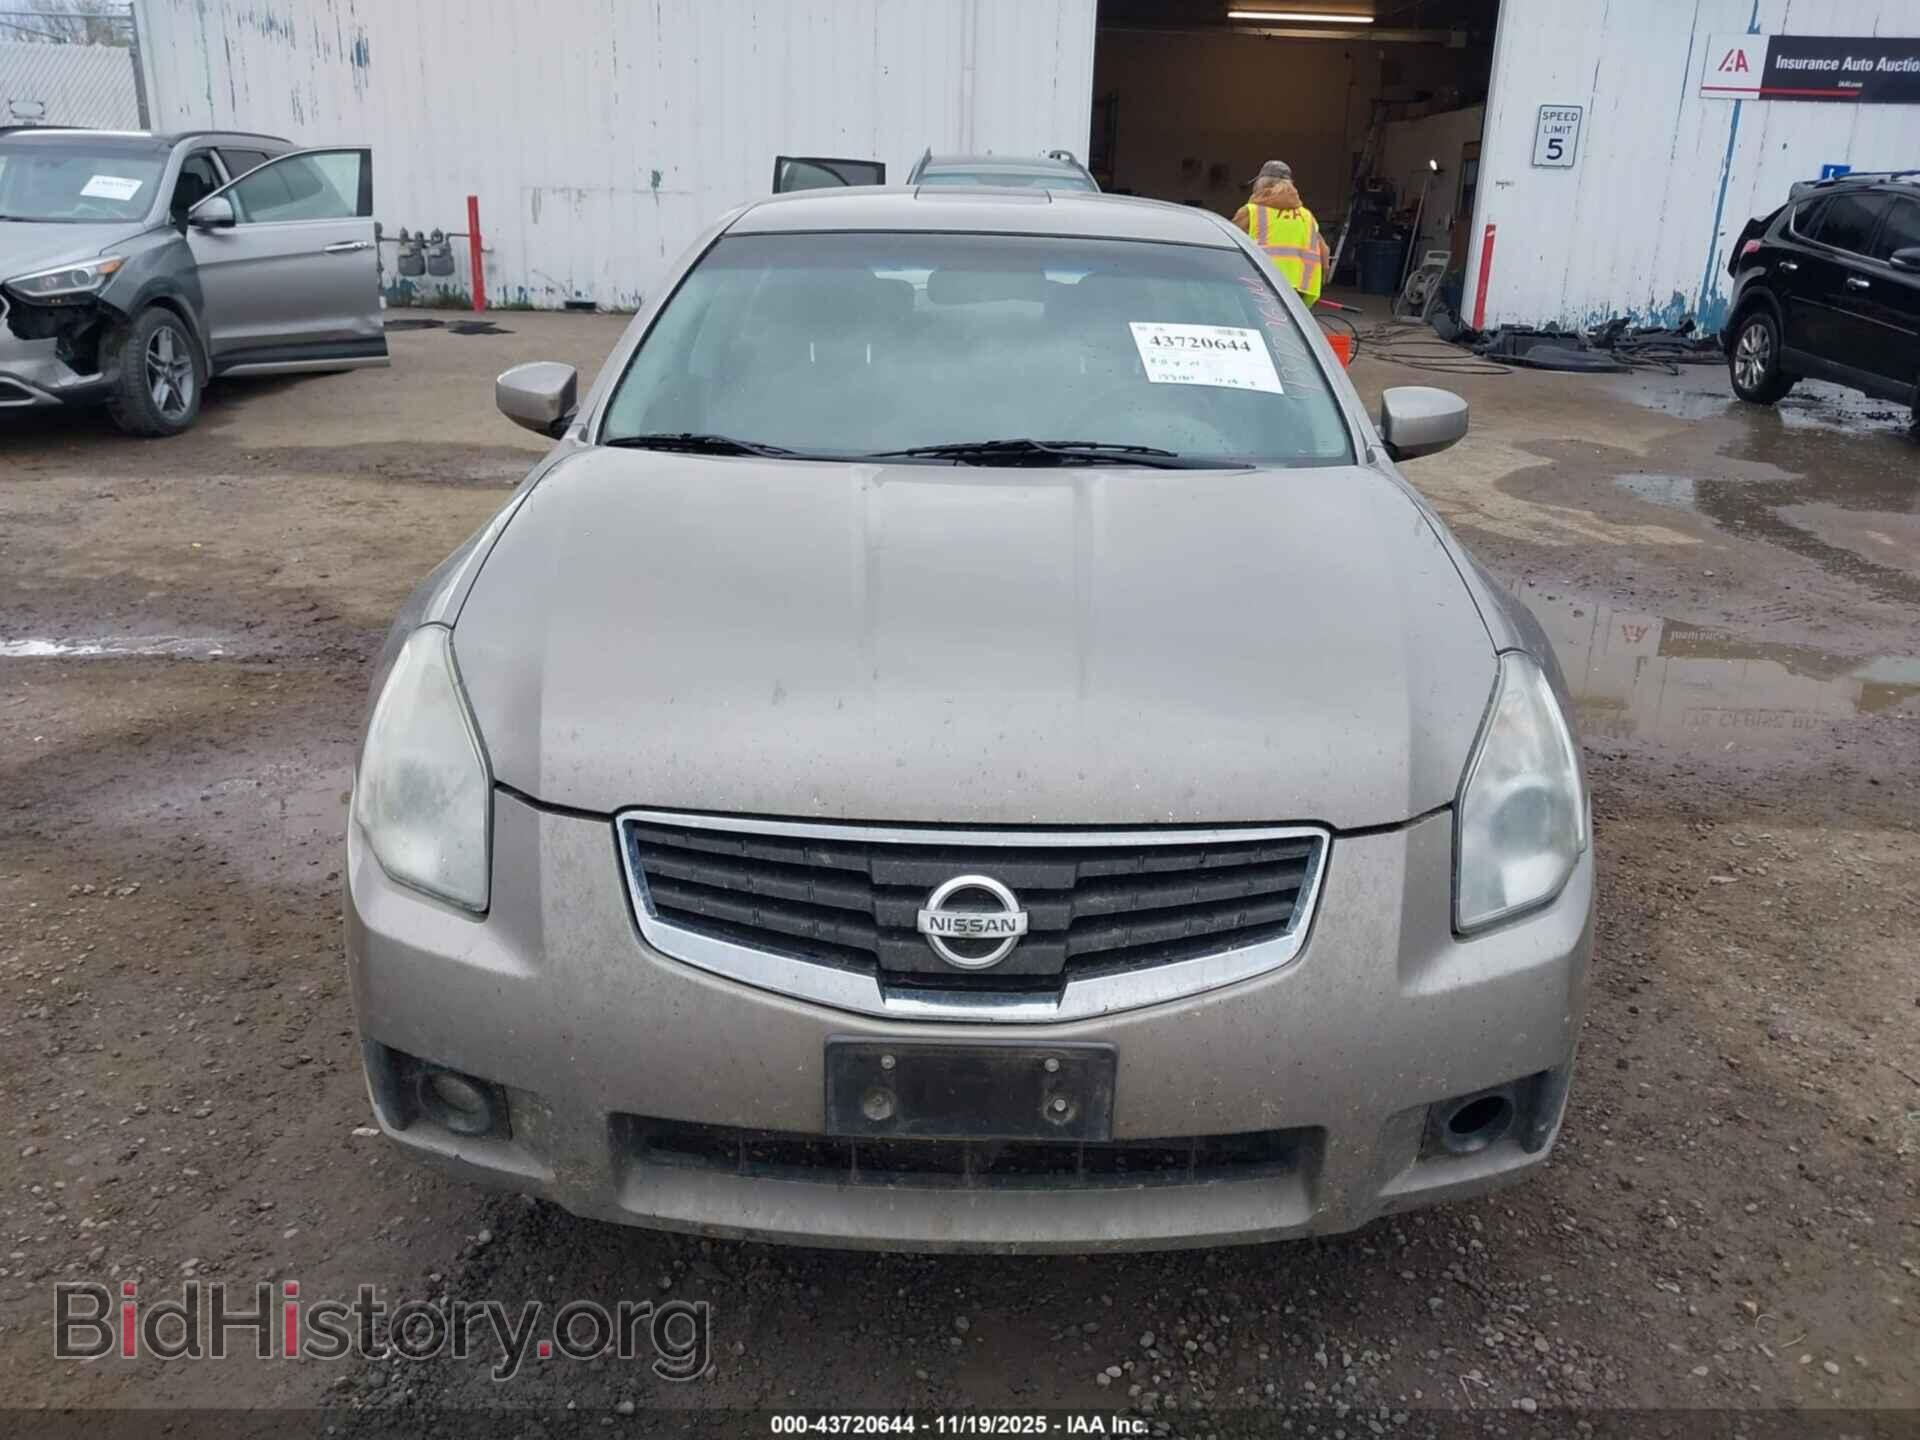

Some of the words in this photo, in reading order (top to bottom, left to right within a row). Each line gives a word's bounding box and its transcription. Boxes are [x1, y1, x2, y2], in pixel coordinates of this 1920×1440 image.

[1776, 54, 1839, 71] Insurance
[1841, 55, 1874, 72] Auto
[1876, 55, 1920, 73] Auctio
[1542, 111, 1578, 121] SPEED
[1543, 123, 1573, 135] LIMIT
[1546, 138, 1564, 160] 5
[1149, 335, 1252, 352] 43720644
[929, 916, 1017, 933] NISSAN
